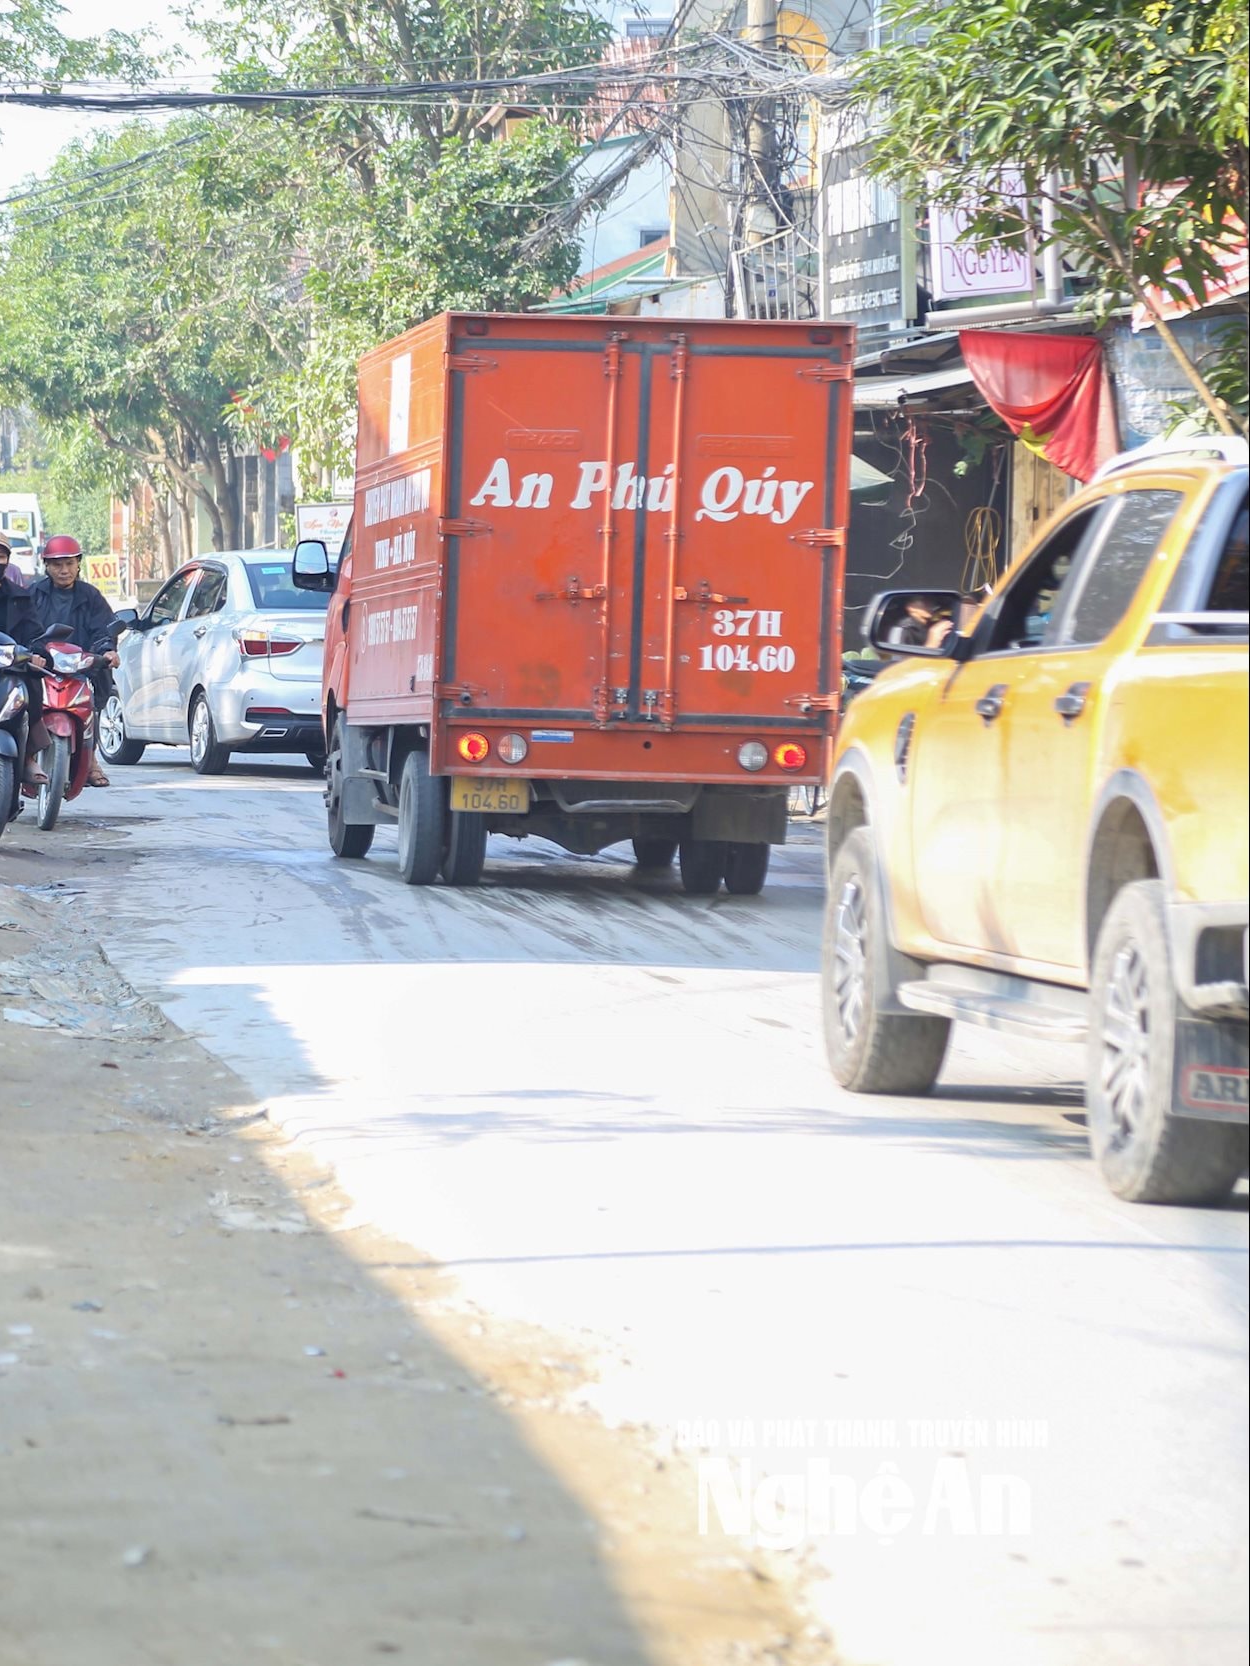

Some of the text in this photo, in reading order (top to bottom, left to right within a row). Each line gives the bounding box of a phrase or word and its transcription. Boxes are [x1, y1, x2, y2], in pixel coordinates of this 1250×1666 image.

[469, 457, 554, 510] An
[569, 459, 676, 515] Phú
[91, 557, 117, 578] XÔI
[711, 609, 783, 638] 37H
[698, 644, 796, 673] 104.60
[463, 793, 519, 810] 104.60
[1193, 1072, 1248, 1103] AR
